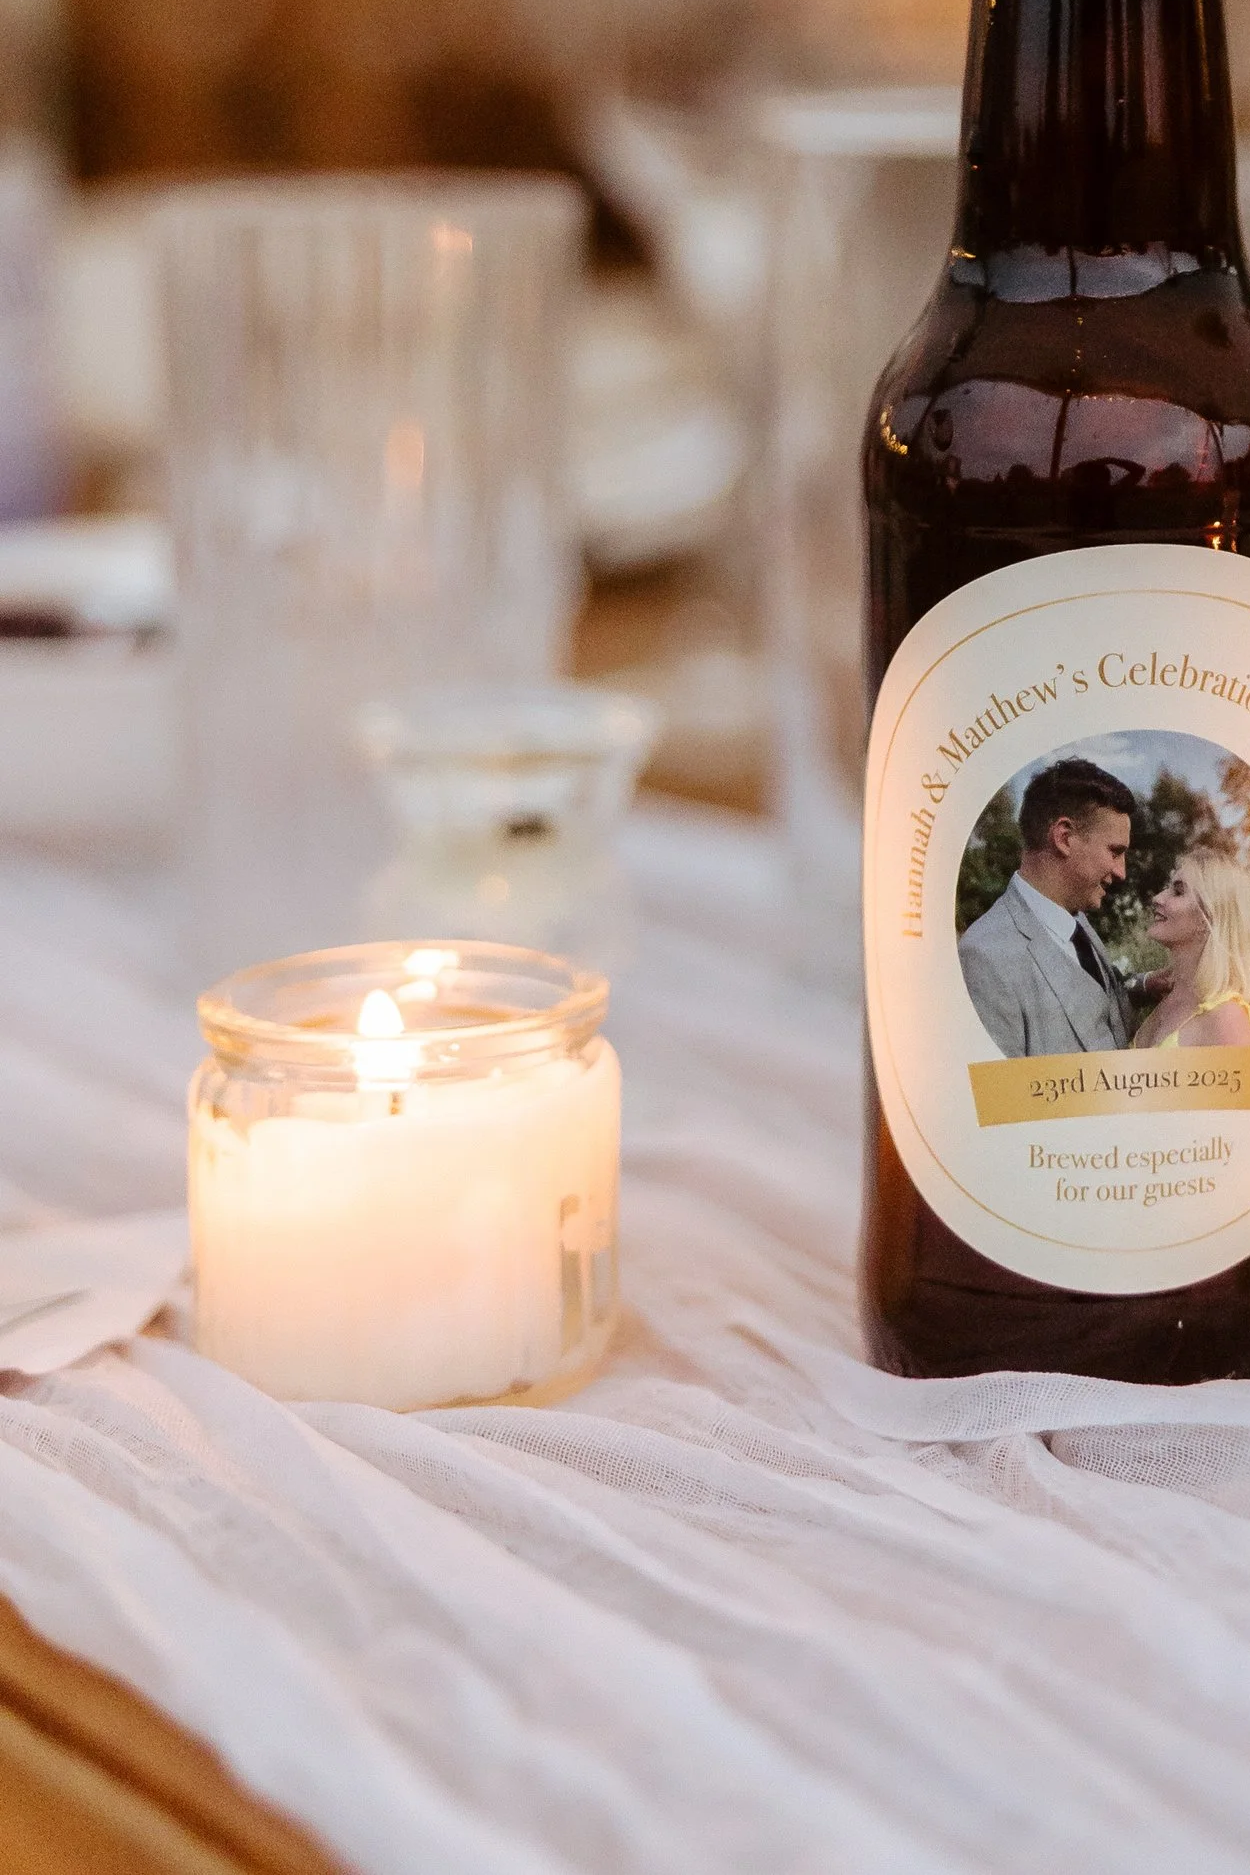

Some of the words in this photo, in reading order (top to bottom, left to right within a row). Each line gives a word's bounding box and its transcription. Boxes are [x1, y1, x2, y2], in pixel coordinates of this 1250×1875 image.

[921, 772, 951, 805] &
[1029, 1068, 1086, 1103] 23rd
[1093, 1067, 1179, 1098] August
[1186, 1069, 1242, 1094] 2025
[1028, 1143, 1119, 1170] Brewed
[1125, 1135, 1234, 1175] especially
[1055, 1176, 1089, 1203] for
[1096, 1180, 1138, 1202] our
[1143, 1175, 1216, 1208] guests
